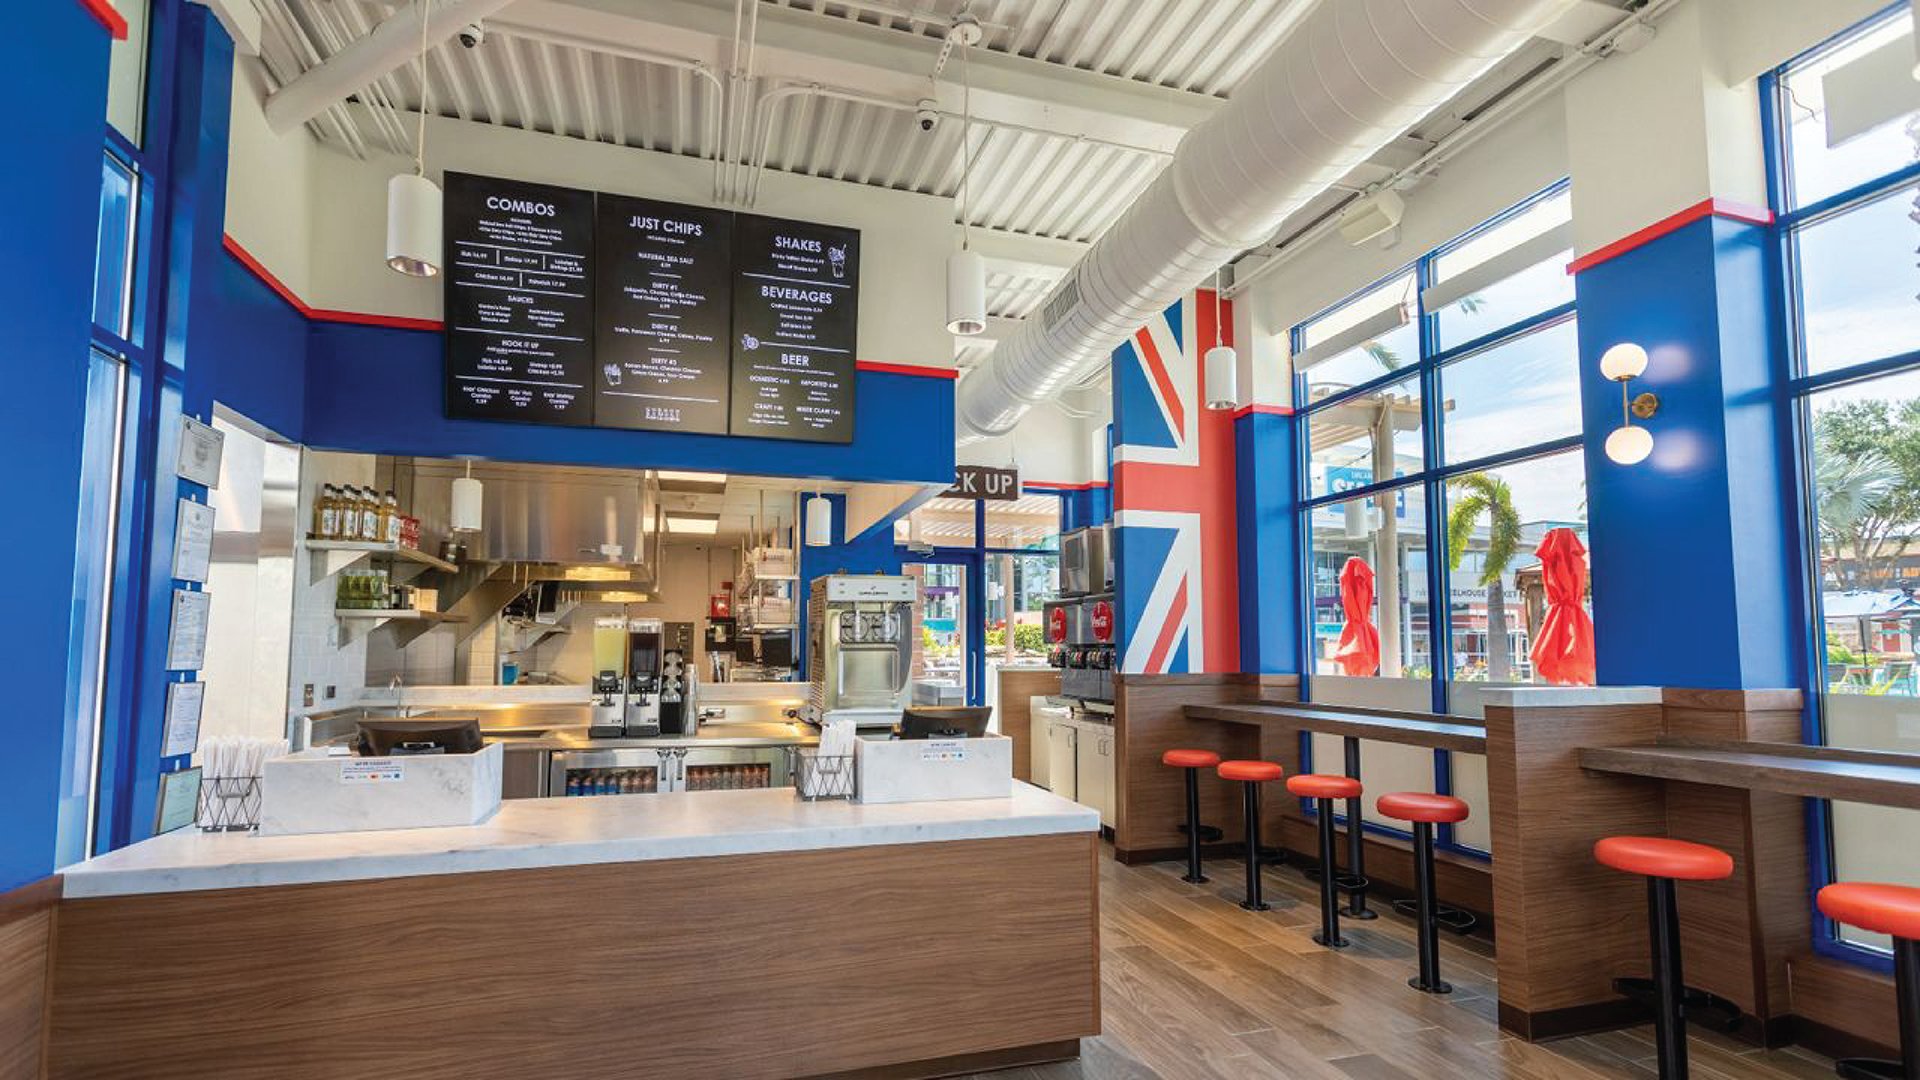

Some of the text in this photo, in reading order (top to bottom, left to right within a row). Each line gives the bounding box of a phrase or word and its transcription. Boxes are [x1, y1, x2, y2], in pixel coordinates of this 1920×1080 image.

[486, 197, 556, 217] COMBOS
[629, 216, 703, 237] JUST CHIPS
[775, 236, 822, 253] SHAKES
[638, 252, 666, 262] NATURAL
[761, 286, 833, 305] BEVERAGES
[781, 354, 810, 366] BEER
[951, 471, 1013, 494] CK UP
